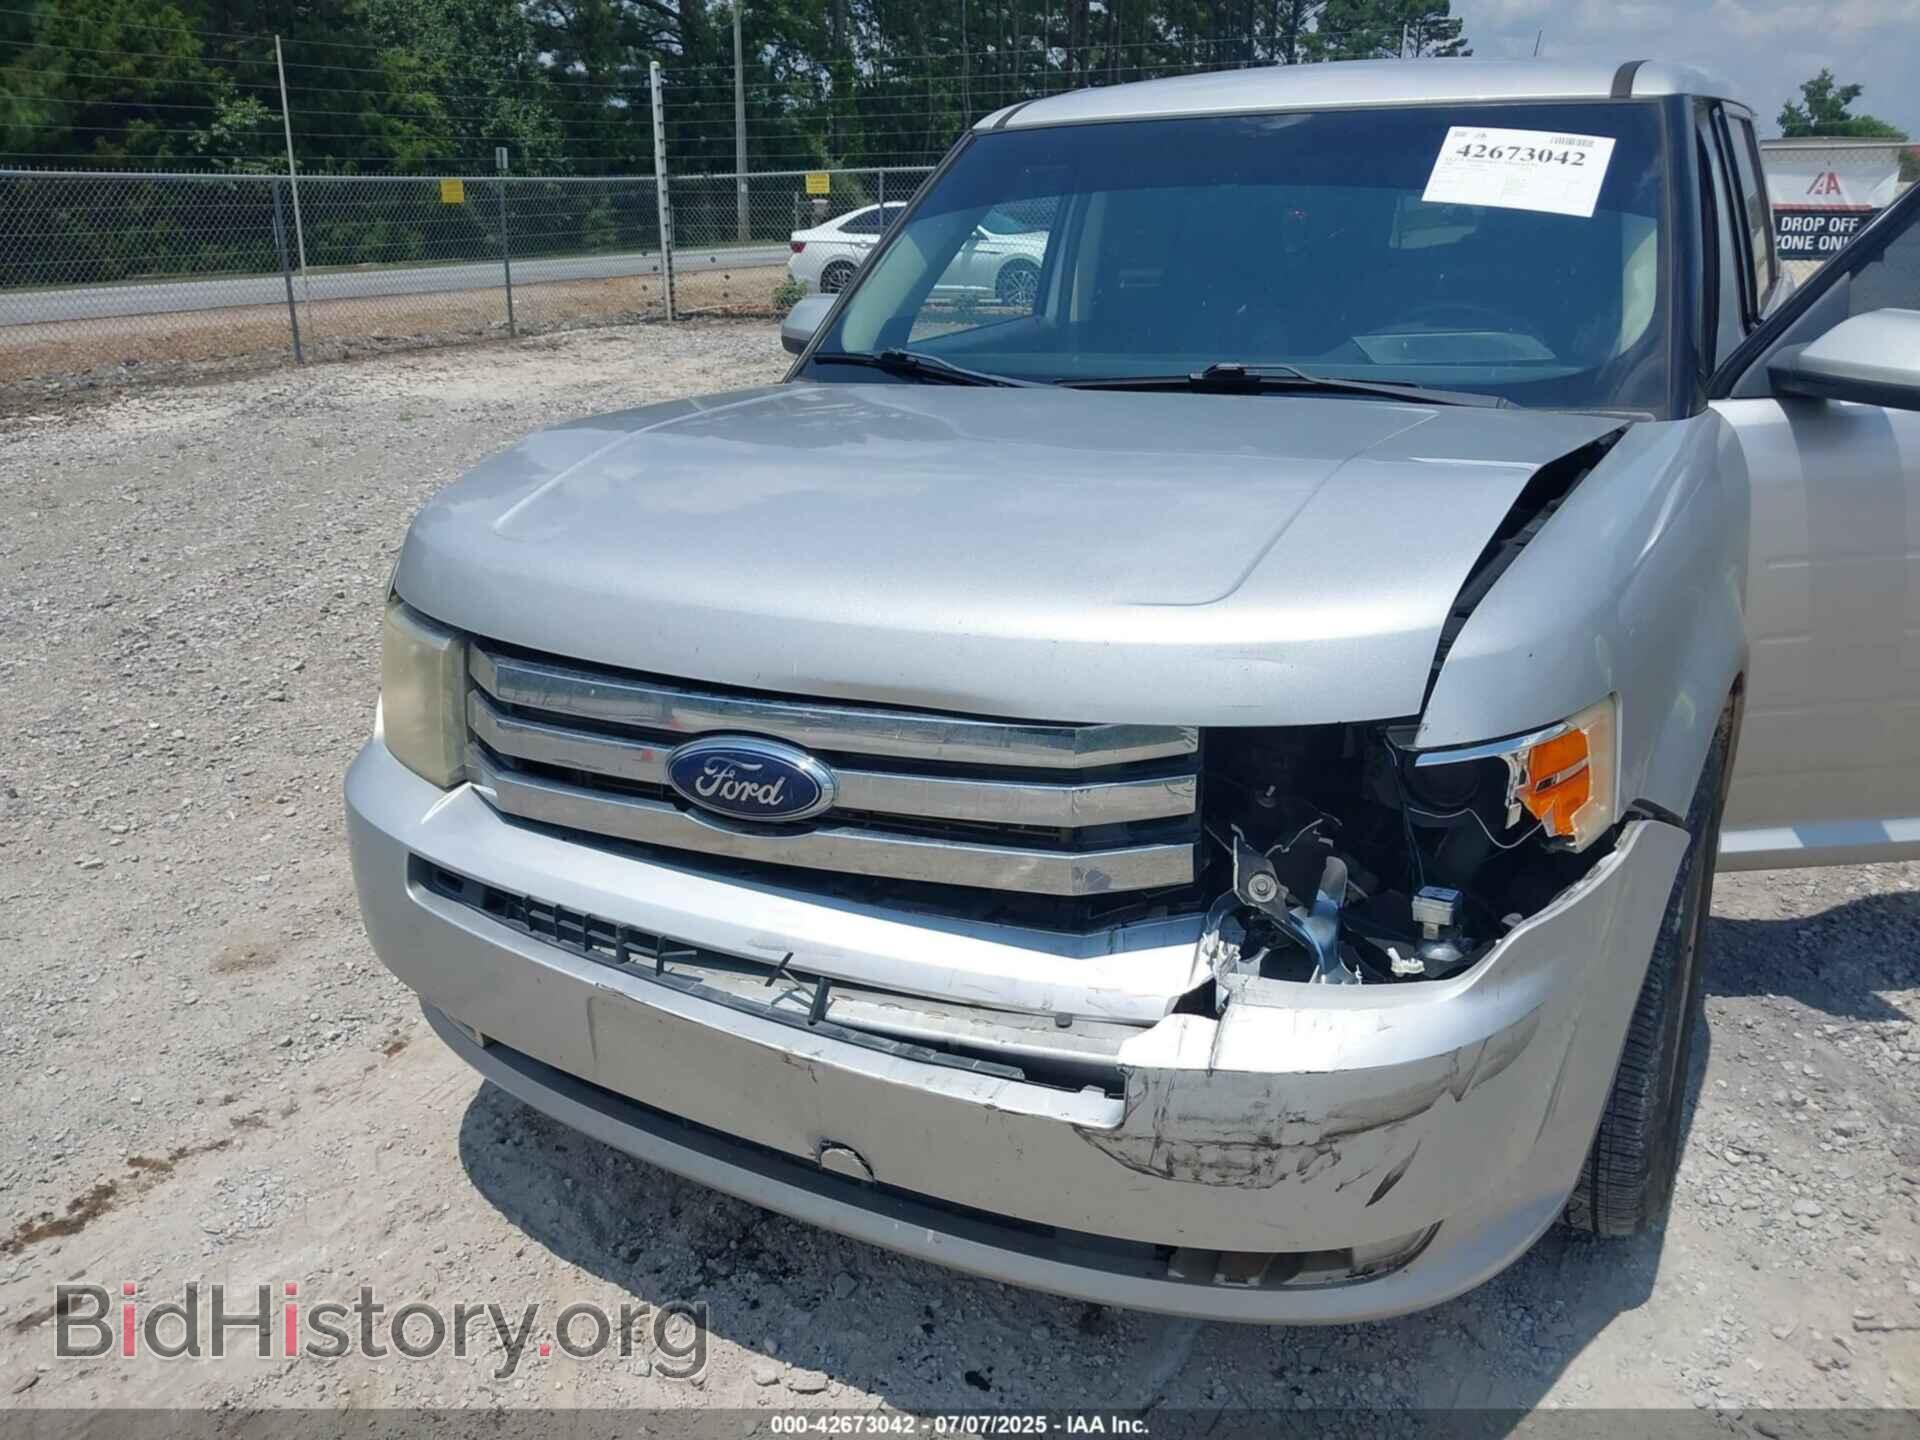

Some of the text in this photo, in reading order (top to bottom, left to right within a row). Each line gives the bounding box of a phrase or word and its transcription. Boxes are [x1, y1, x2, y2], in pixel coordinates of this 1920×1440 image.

[1456, 143, 1586, 166] 42673042
[1780, 217, 1859, 232] DROP OFF
[695, 757, 785, 806] Ford
